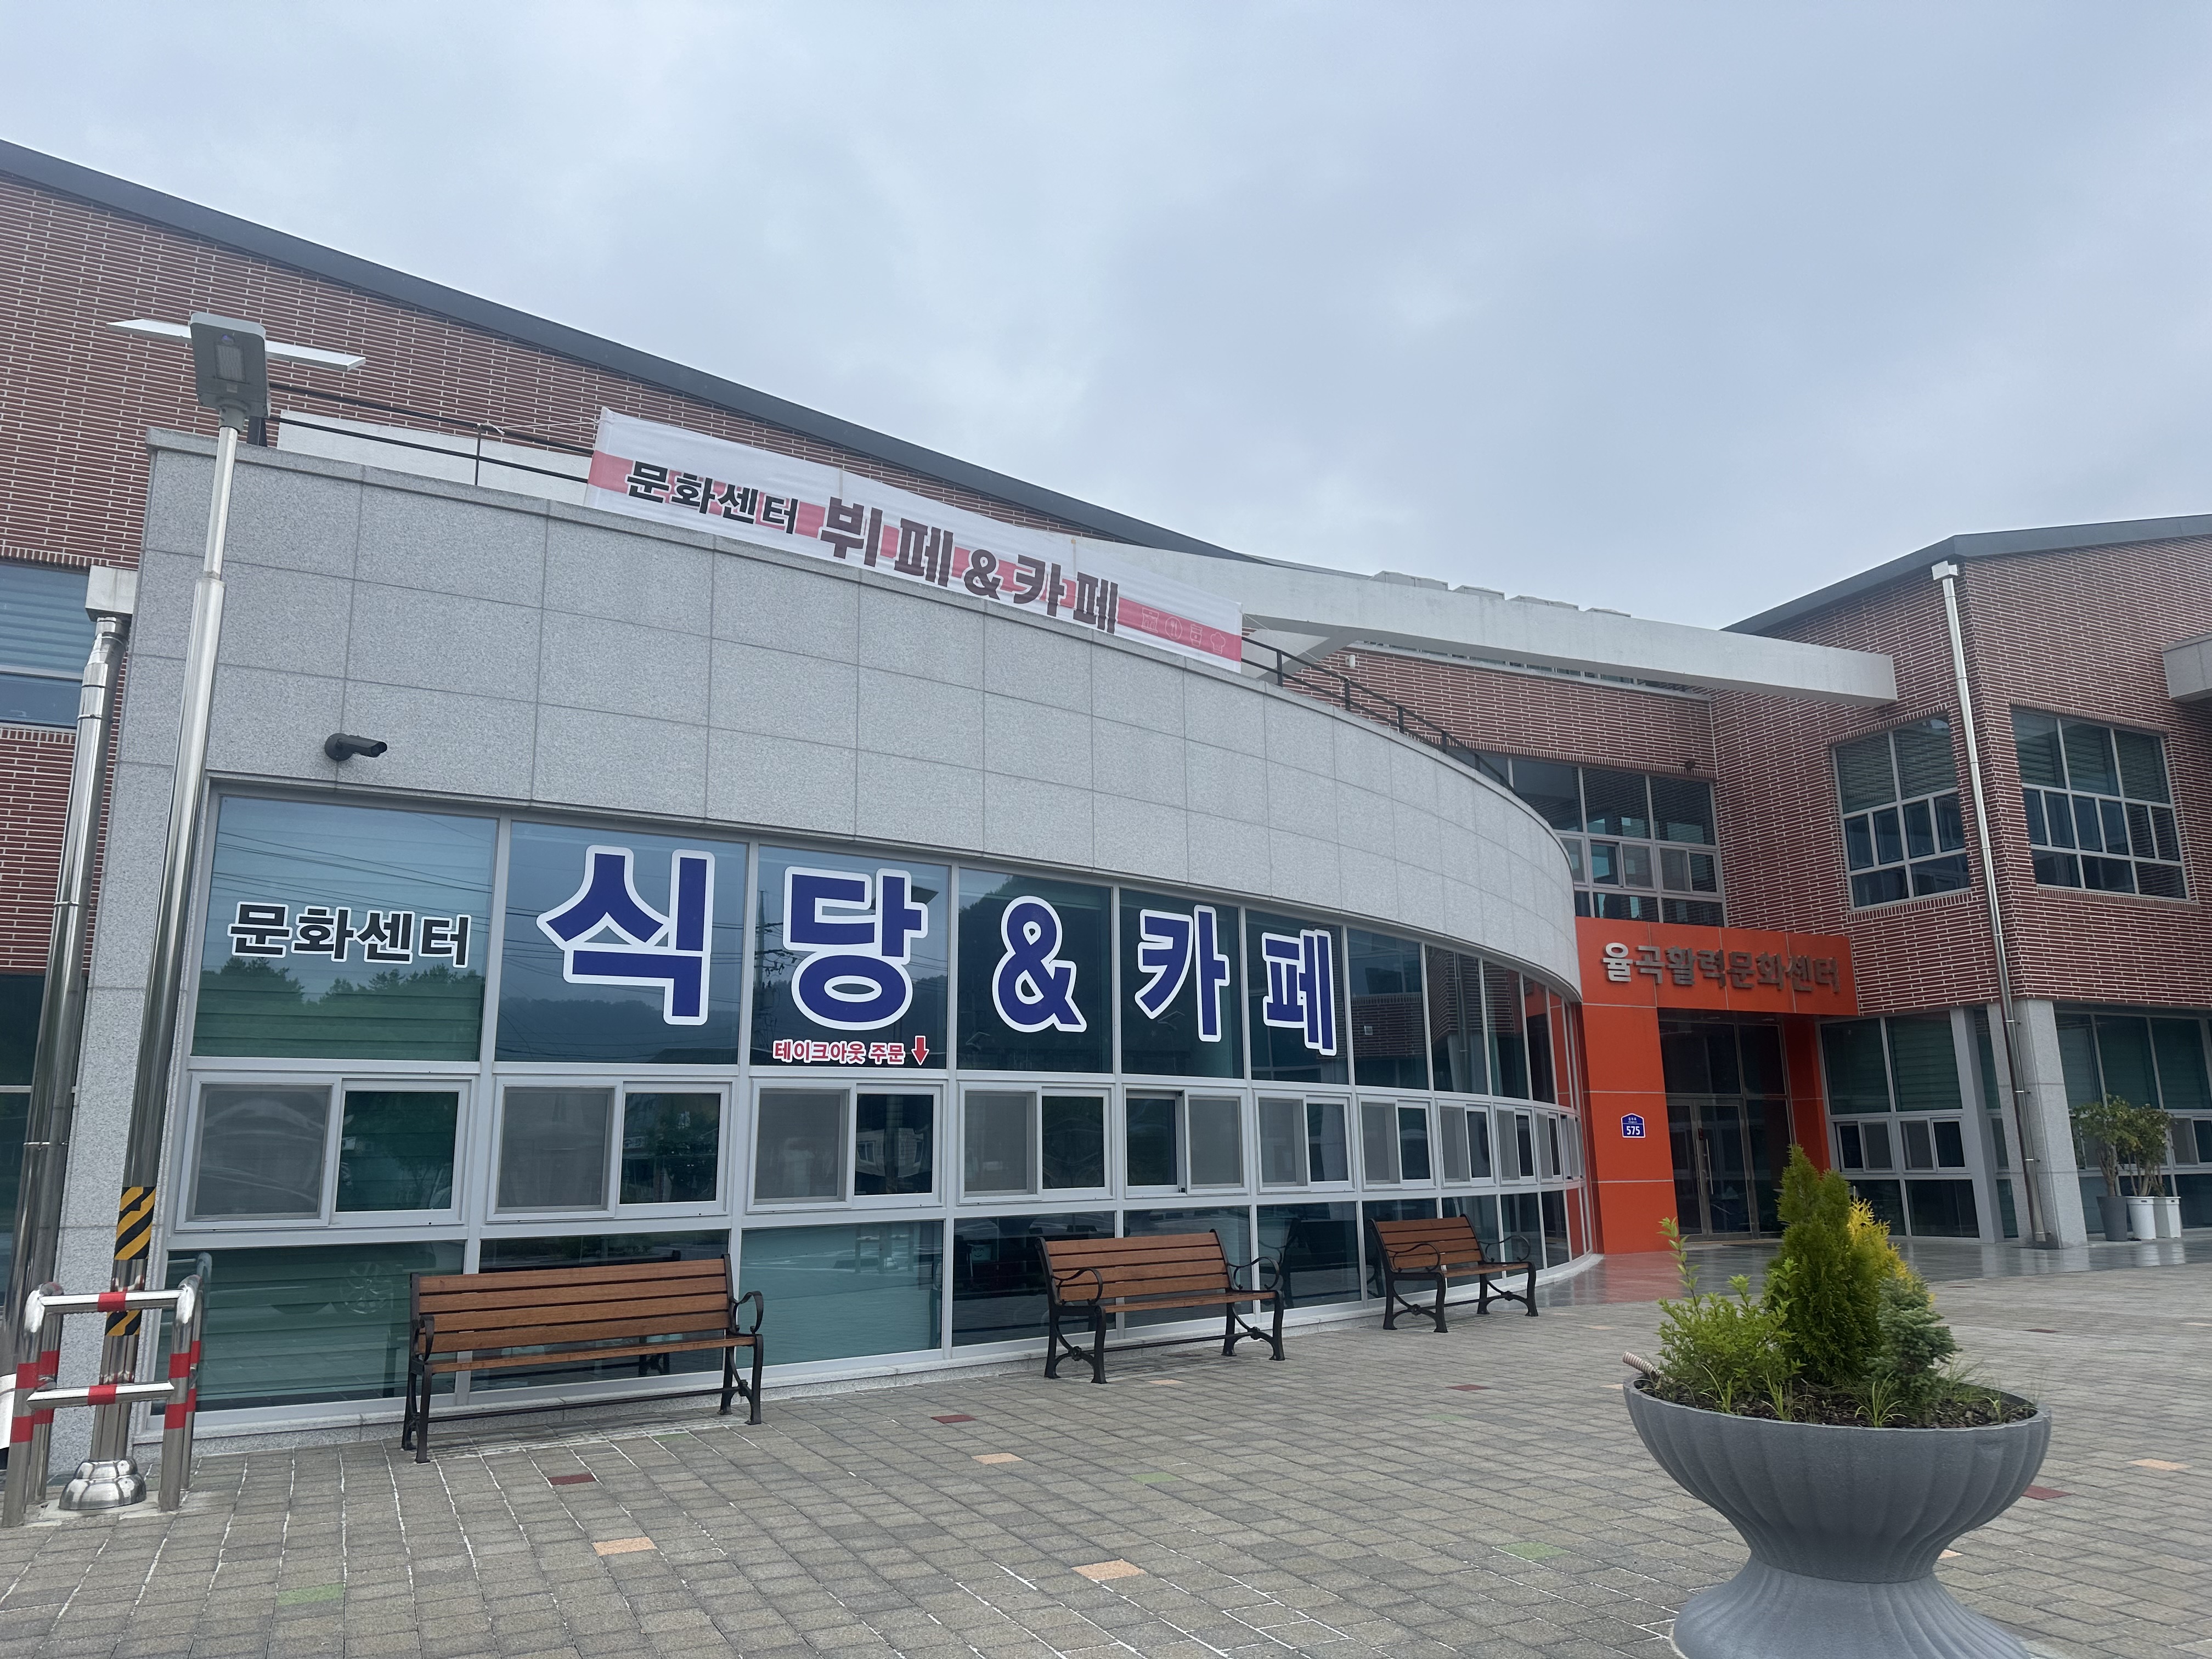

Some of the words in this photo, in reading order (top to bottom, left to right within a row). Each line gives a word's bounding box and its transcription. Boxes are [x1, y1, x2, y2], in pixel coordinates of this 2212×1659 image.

[627, 461, 799, 535] 문화센터
[228, 901, 471, 967] 문화센터
[538, 847, 927, 1029] 식당
[992, 896, 1087, 1032] &
[1135, 905, 1336, 1056] 카페
[773, 1040, 866, 1063] 테이크아웃
[869, 1043, 905, 1064] 주문
[1626, 1126, 1640, 1135] 575
